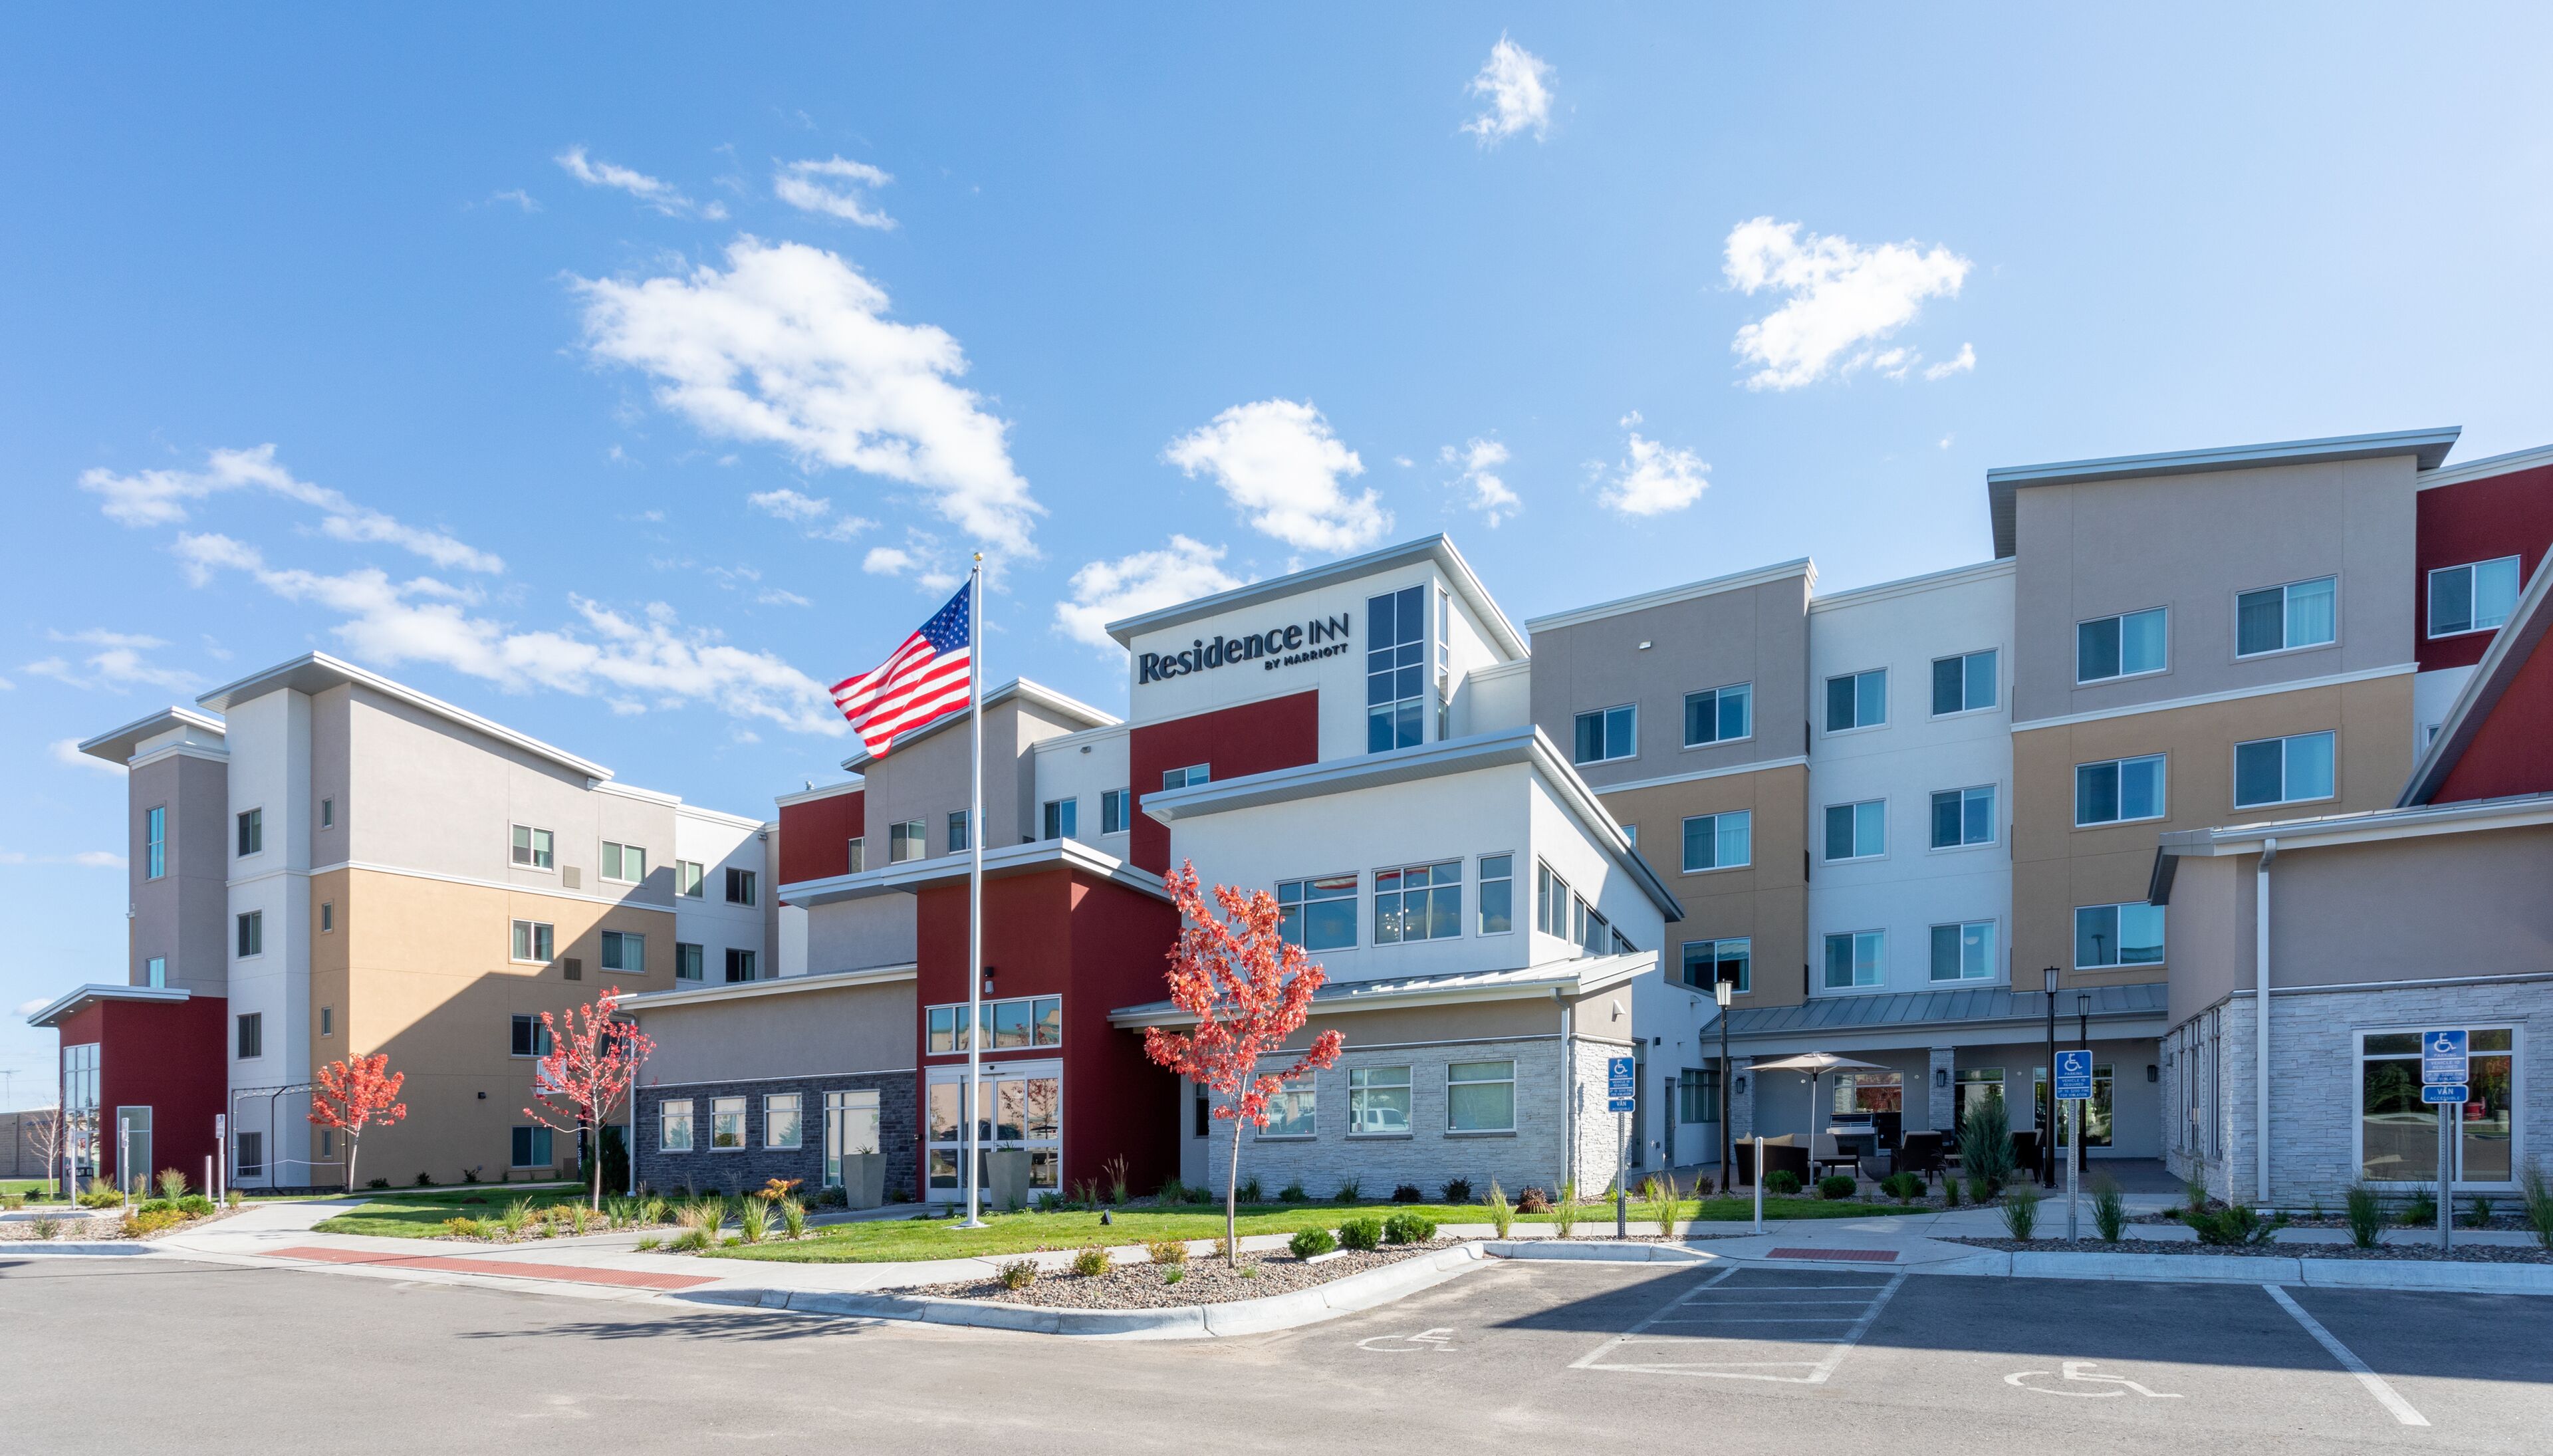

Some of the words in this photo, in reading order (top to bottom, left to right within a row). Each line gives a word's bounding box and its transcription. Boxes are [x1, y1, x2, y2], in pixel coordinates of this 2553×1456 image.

[1139, 625, 1302, 684] Residence
[1308, 612, 1348, 644] INN
[1265, 658, 1280, 670] BY
[1284, 643, 1348, 666] MARRIOTT
